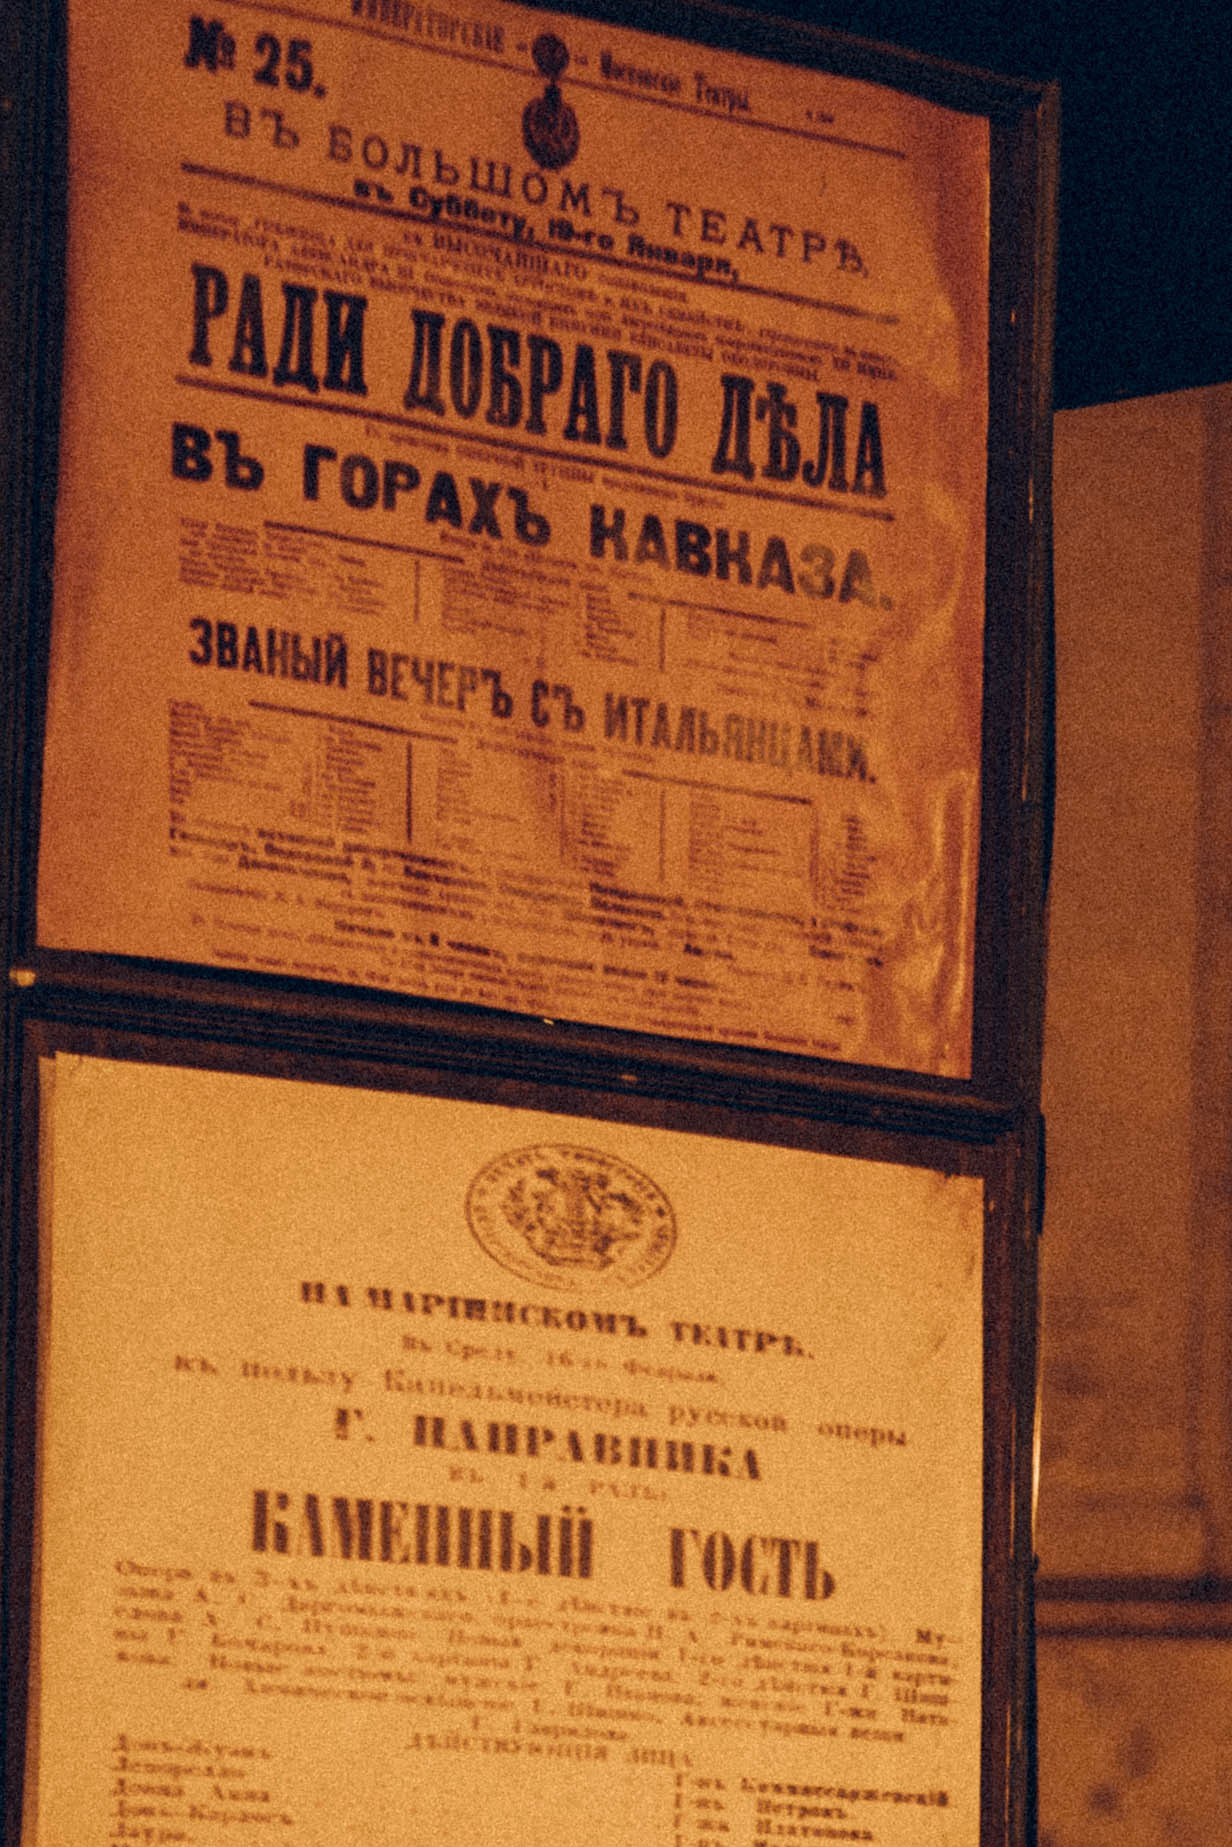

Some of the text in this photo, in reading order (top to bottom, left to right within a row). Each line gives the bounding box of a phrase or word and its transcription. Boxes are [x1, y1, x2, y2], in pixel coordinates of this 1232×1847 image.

[184, 15, 327, 98] № 25.
[224, 101, 300, 150] ВЪ
[327, 123, 641, 227] БОЛЬШОМЪ
[188, 262, 368, 397] РАДИ
[403, 308, 679, 458] ДОБРАГО
[711, 372, 888, 498] ДѢЛА
[170, 421, 265, 492] ВЪ
[303, 442, 552, 548] ГОРАХЪ
[589, 502, 894, 612] КАВКАЗА.
[188, 616, 348, 690] ЗВАНЫЙ
[367, 646, 514, 719] ВЕЧЕРЪ
[531, 678, 585, 733] СЪ
[413, 1414, 762, 1480] НАПРАВНИКА
[252, 1489, 594, 1579] КАМЕННЫЙ
[669, 1526, 837, 1601] ГОСТЬ
